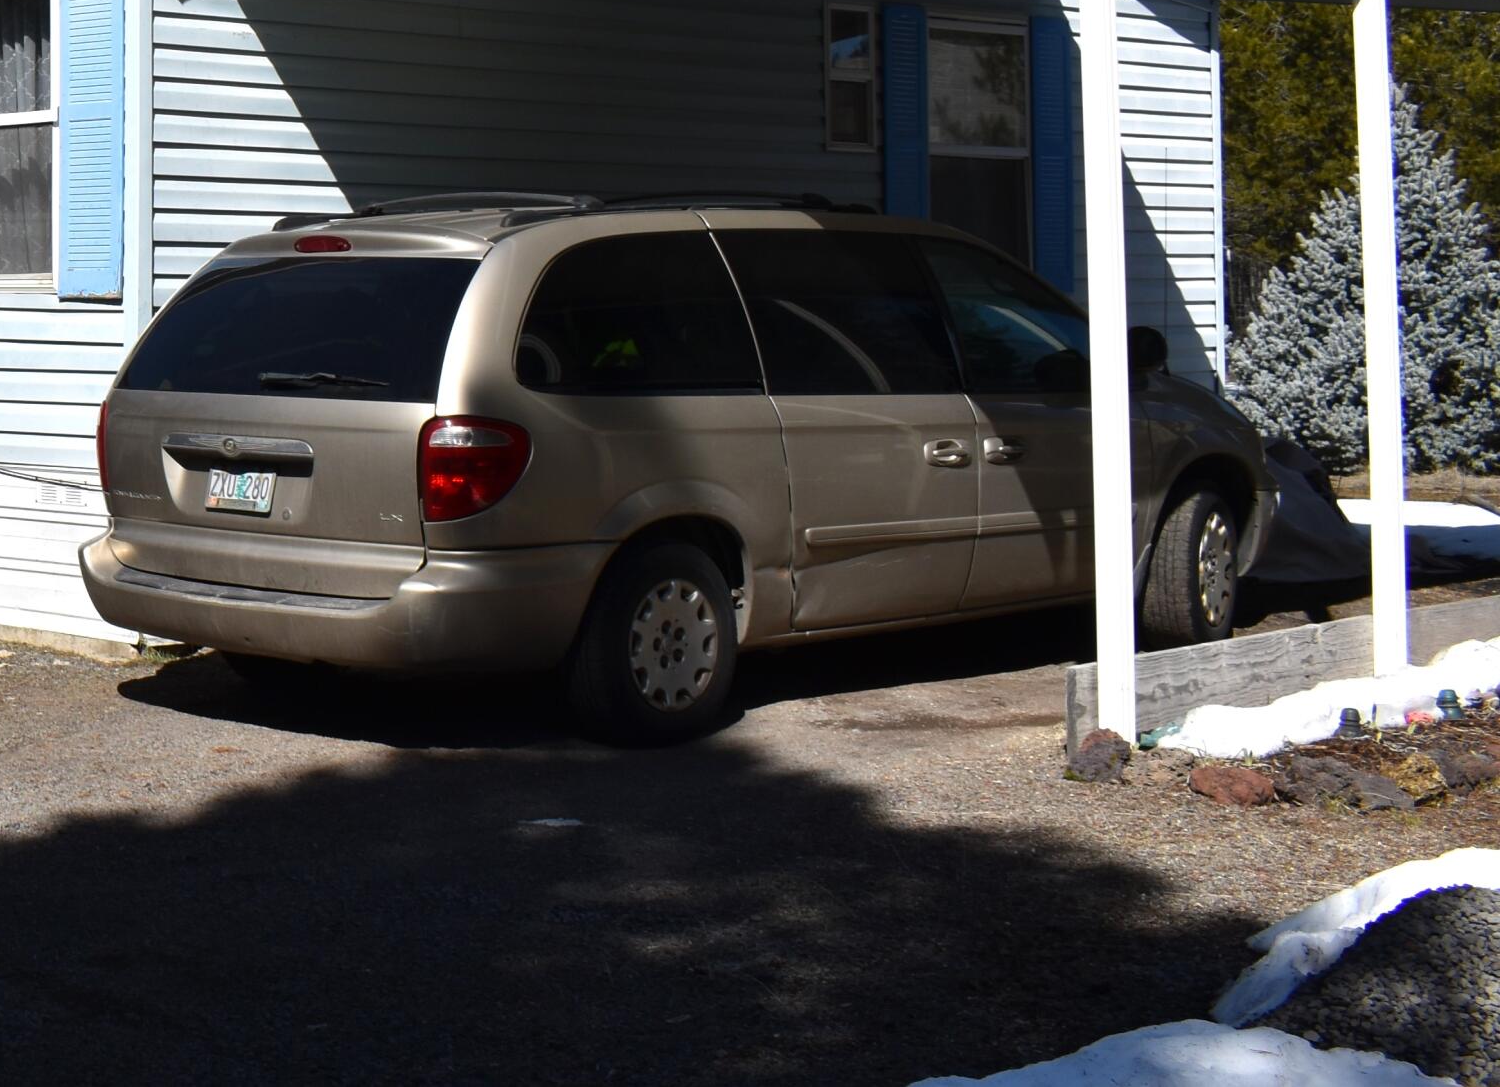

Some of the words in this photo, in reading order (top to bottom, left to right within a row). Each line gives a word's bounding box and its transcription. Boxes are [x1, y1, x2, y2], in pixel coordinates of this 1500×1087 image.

[210, 472, 237, 497] ZXU
[244, 475, 270, 500] 280
[380, 512, 404, 522] LX
